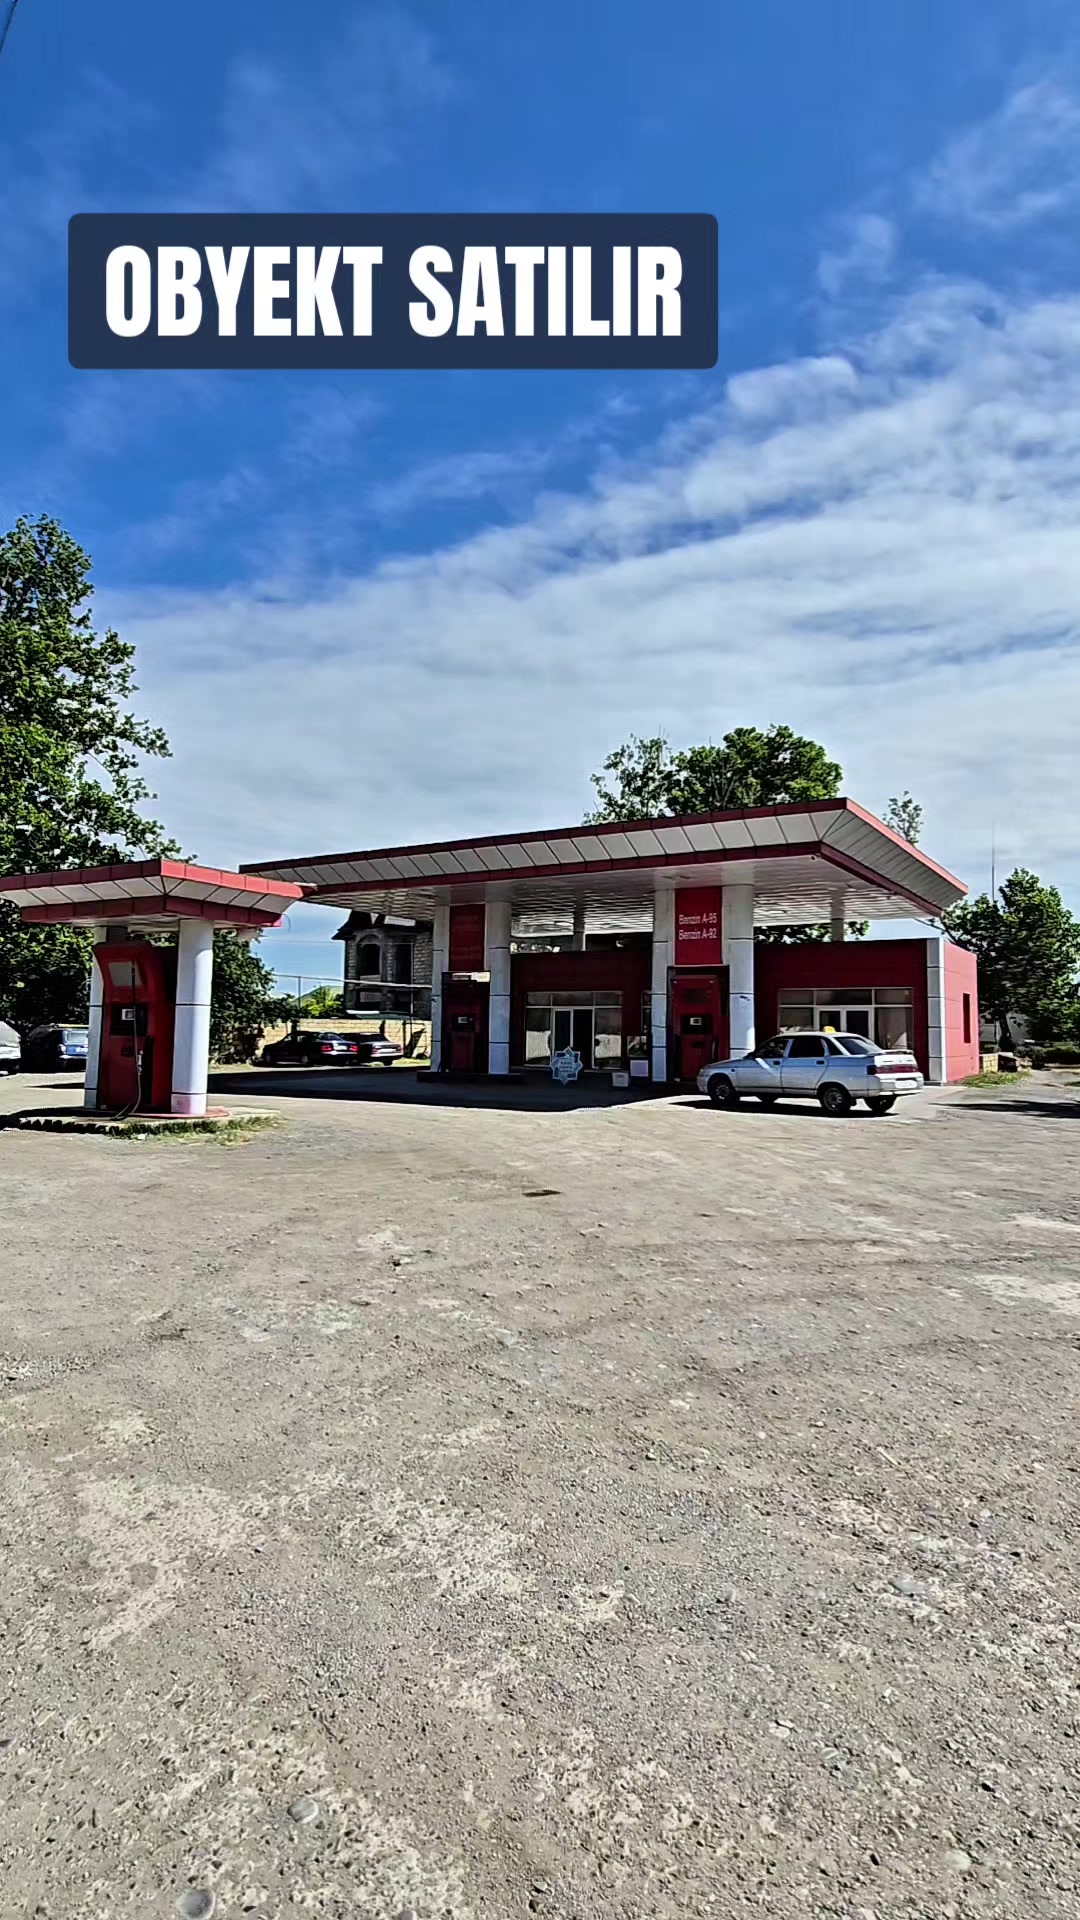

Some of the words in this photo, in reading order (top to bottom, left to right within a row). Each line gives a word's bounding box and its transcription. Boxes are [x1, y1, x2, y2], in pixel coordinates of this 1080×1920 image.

[679, 914, 701, 924] Benzin
[701, 912, 717, 924] A-95
[679, 929, 701, 940] Benzin
[701, 928, 717, 939] A-92
